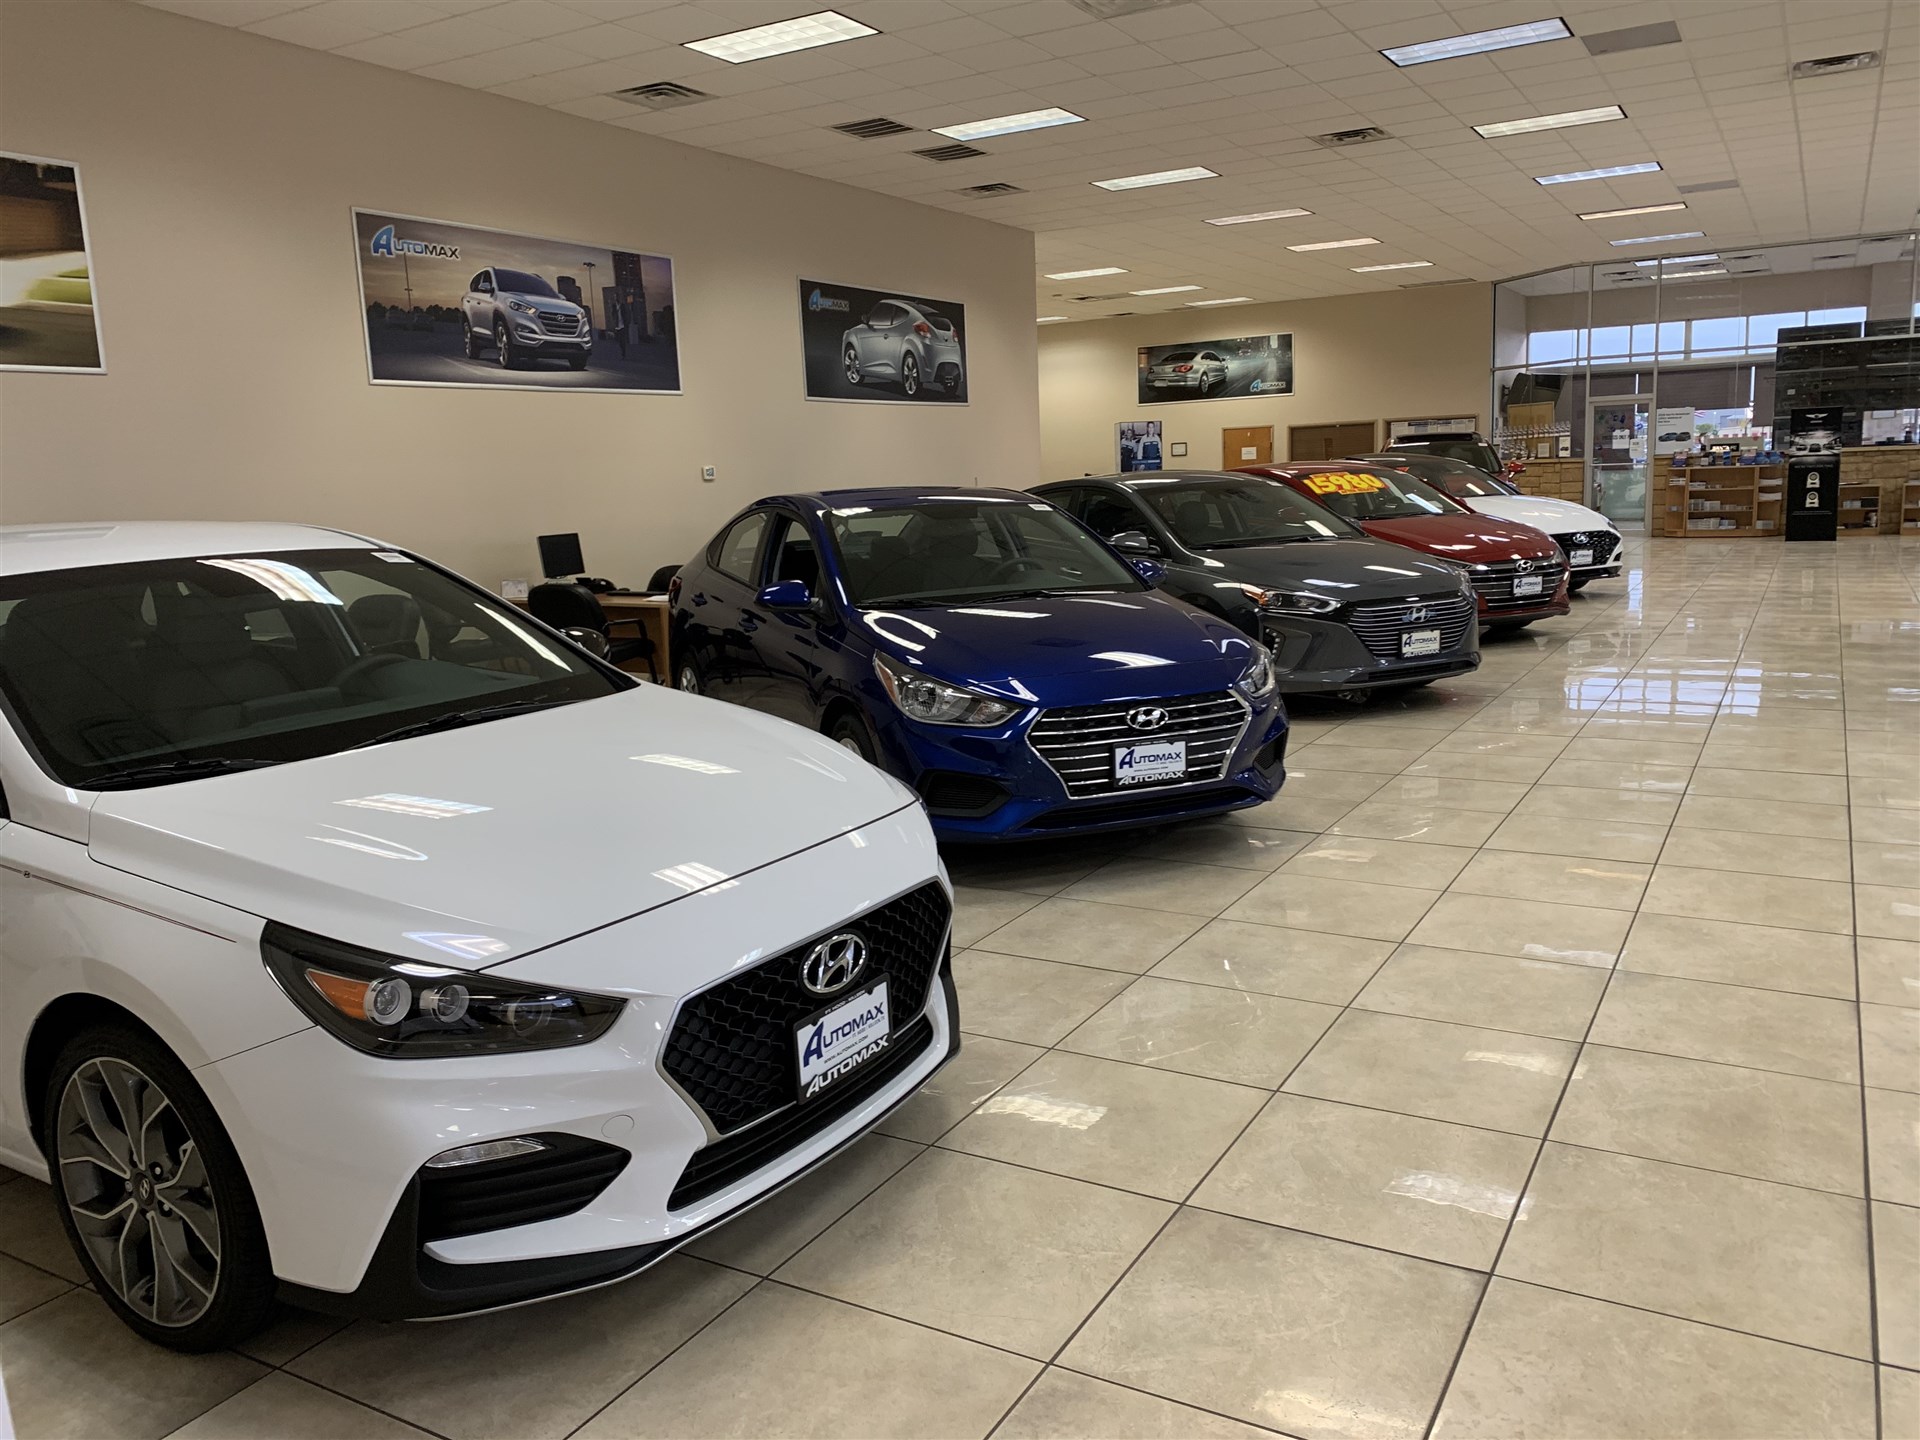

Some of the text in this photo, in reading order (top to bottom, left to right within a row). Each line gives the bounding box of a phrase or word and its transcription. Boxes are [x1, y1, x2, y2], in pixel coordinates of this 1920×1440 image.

[371, 224, 460, 260] AUTOMAX
[1250, 379, 1286, 392] AUTOMAX
[1303, 473, 1385, 494] 15980
[1404, 635, 1438, 648] AUTOMAX
[1119, 748, 1182, 770] AUTOMAX
[1119, 771, 1184, 785] AUTOMAX
[803, 1001, 884, 1068] AUTOMAX
[806, 1034, 889, 1098] AUTOMAX
